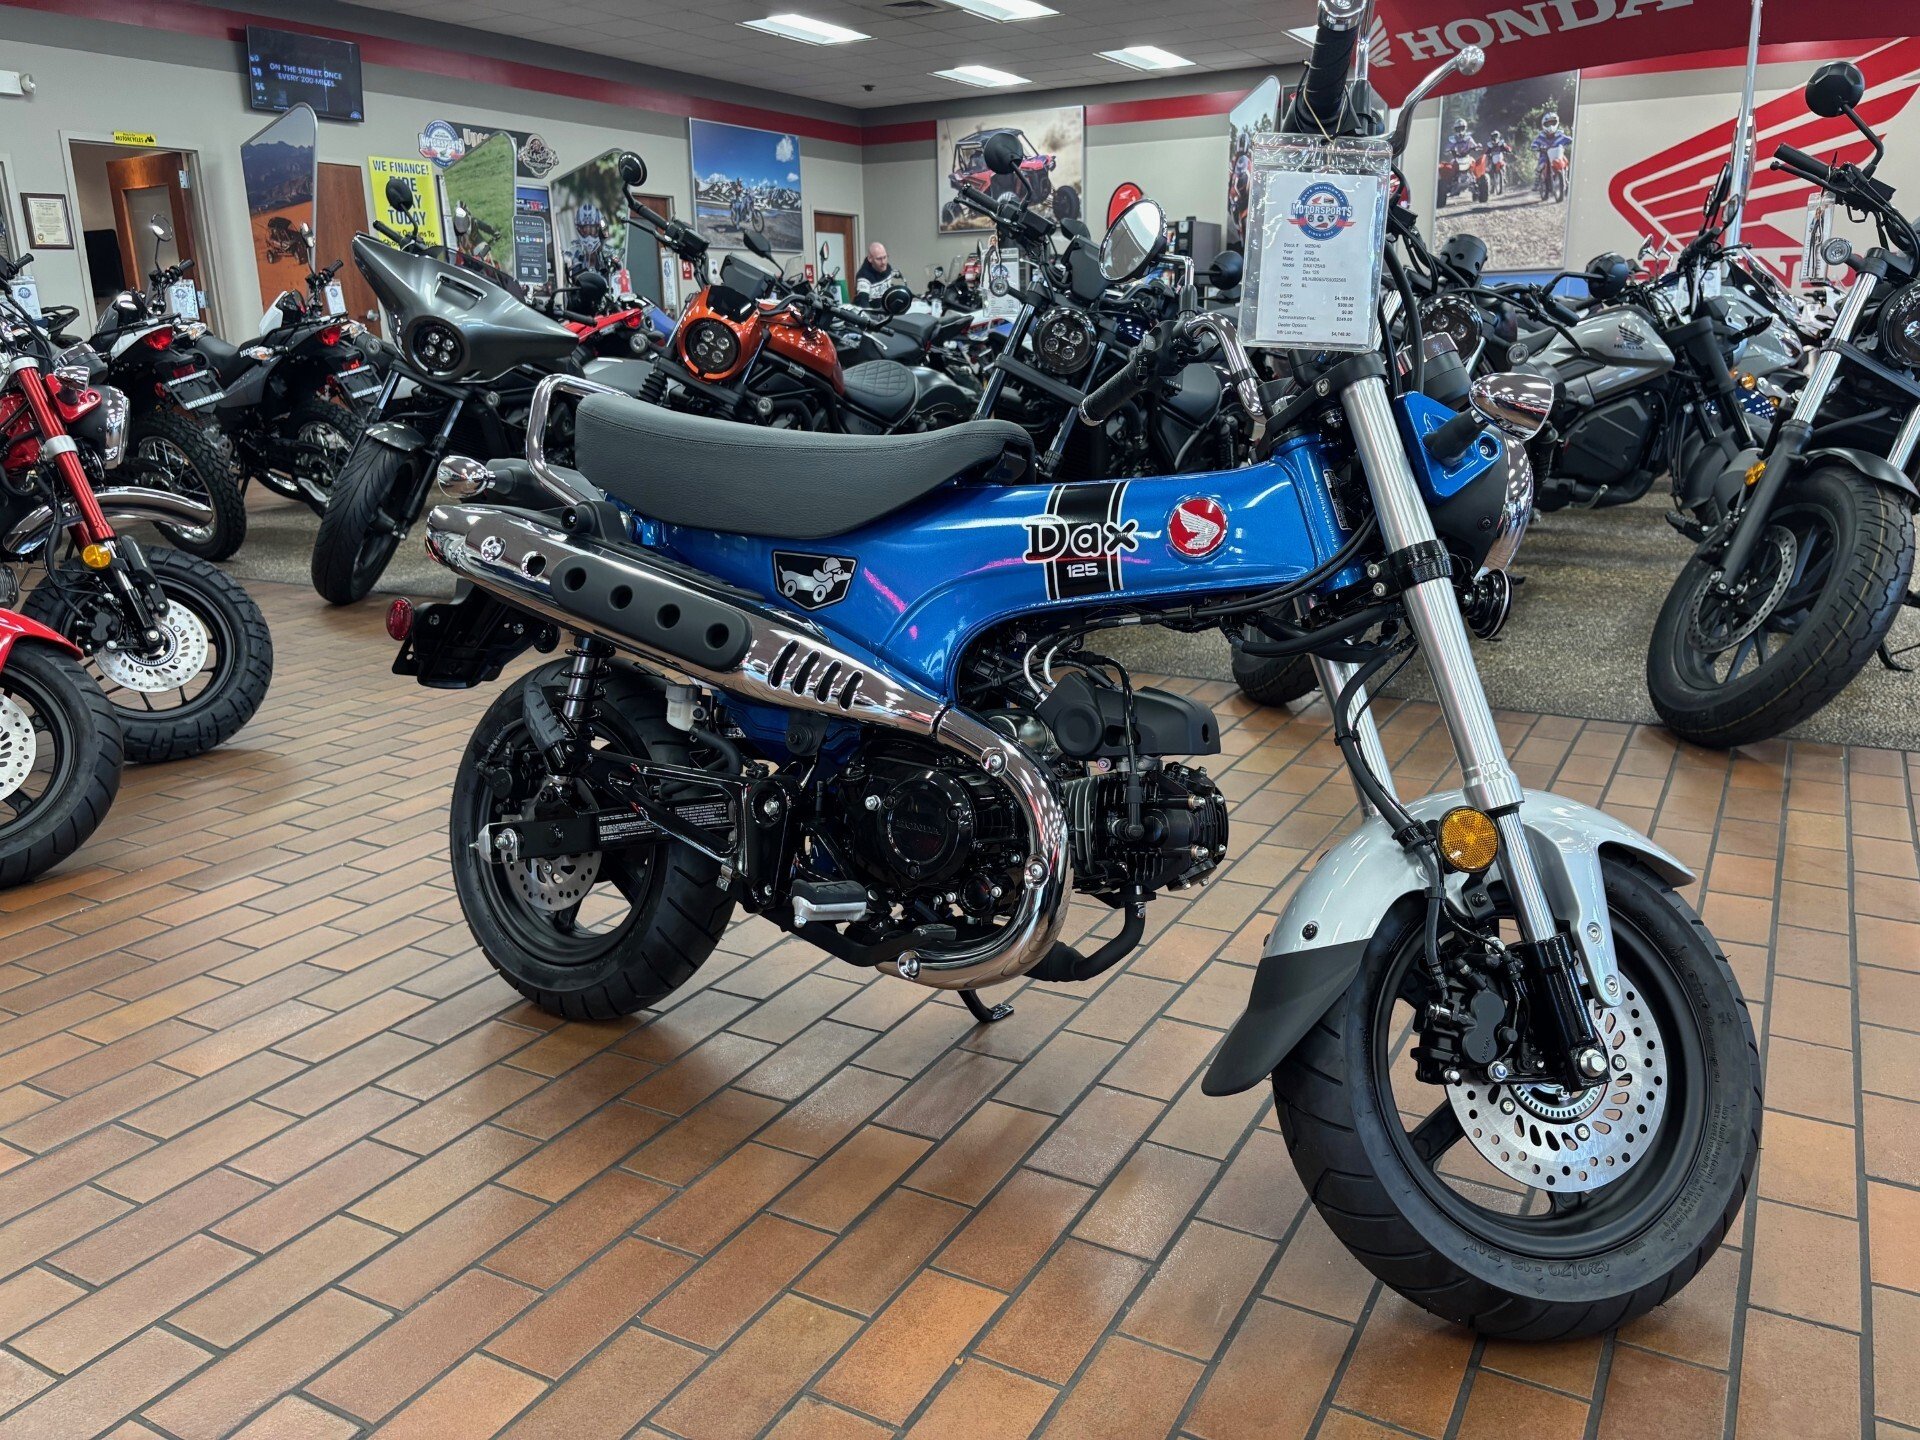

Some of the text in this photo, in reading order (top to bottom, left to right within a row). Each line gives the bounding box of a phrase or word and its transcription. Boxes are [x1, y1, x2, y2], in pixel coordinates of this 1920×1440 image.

[269, 62, 281, 71] ON
[283, 64, 297, 73] THE
[323, 70, 342, 80] ONCE
[277, 72, 299, 82] EVERY
[301, 76, 314, 84] 200
[419, 133, 465, 155] MOTORSPORTS
[372, 160, 387, 172] WE
[389, 161, 429, 176] FINANCE!
[1291, 202, 1353, 218] MOTORSPORTS
[1021, 513, 1139, 564] Dax
[1066, 562, 1099, 578] 125
